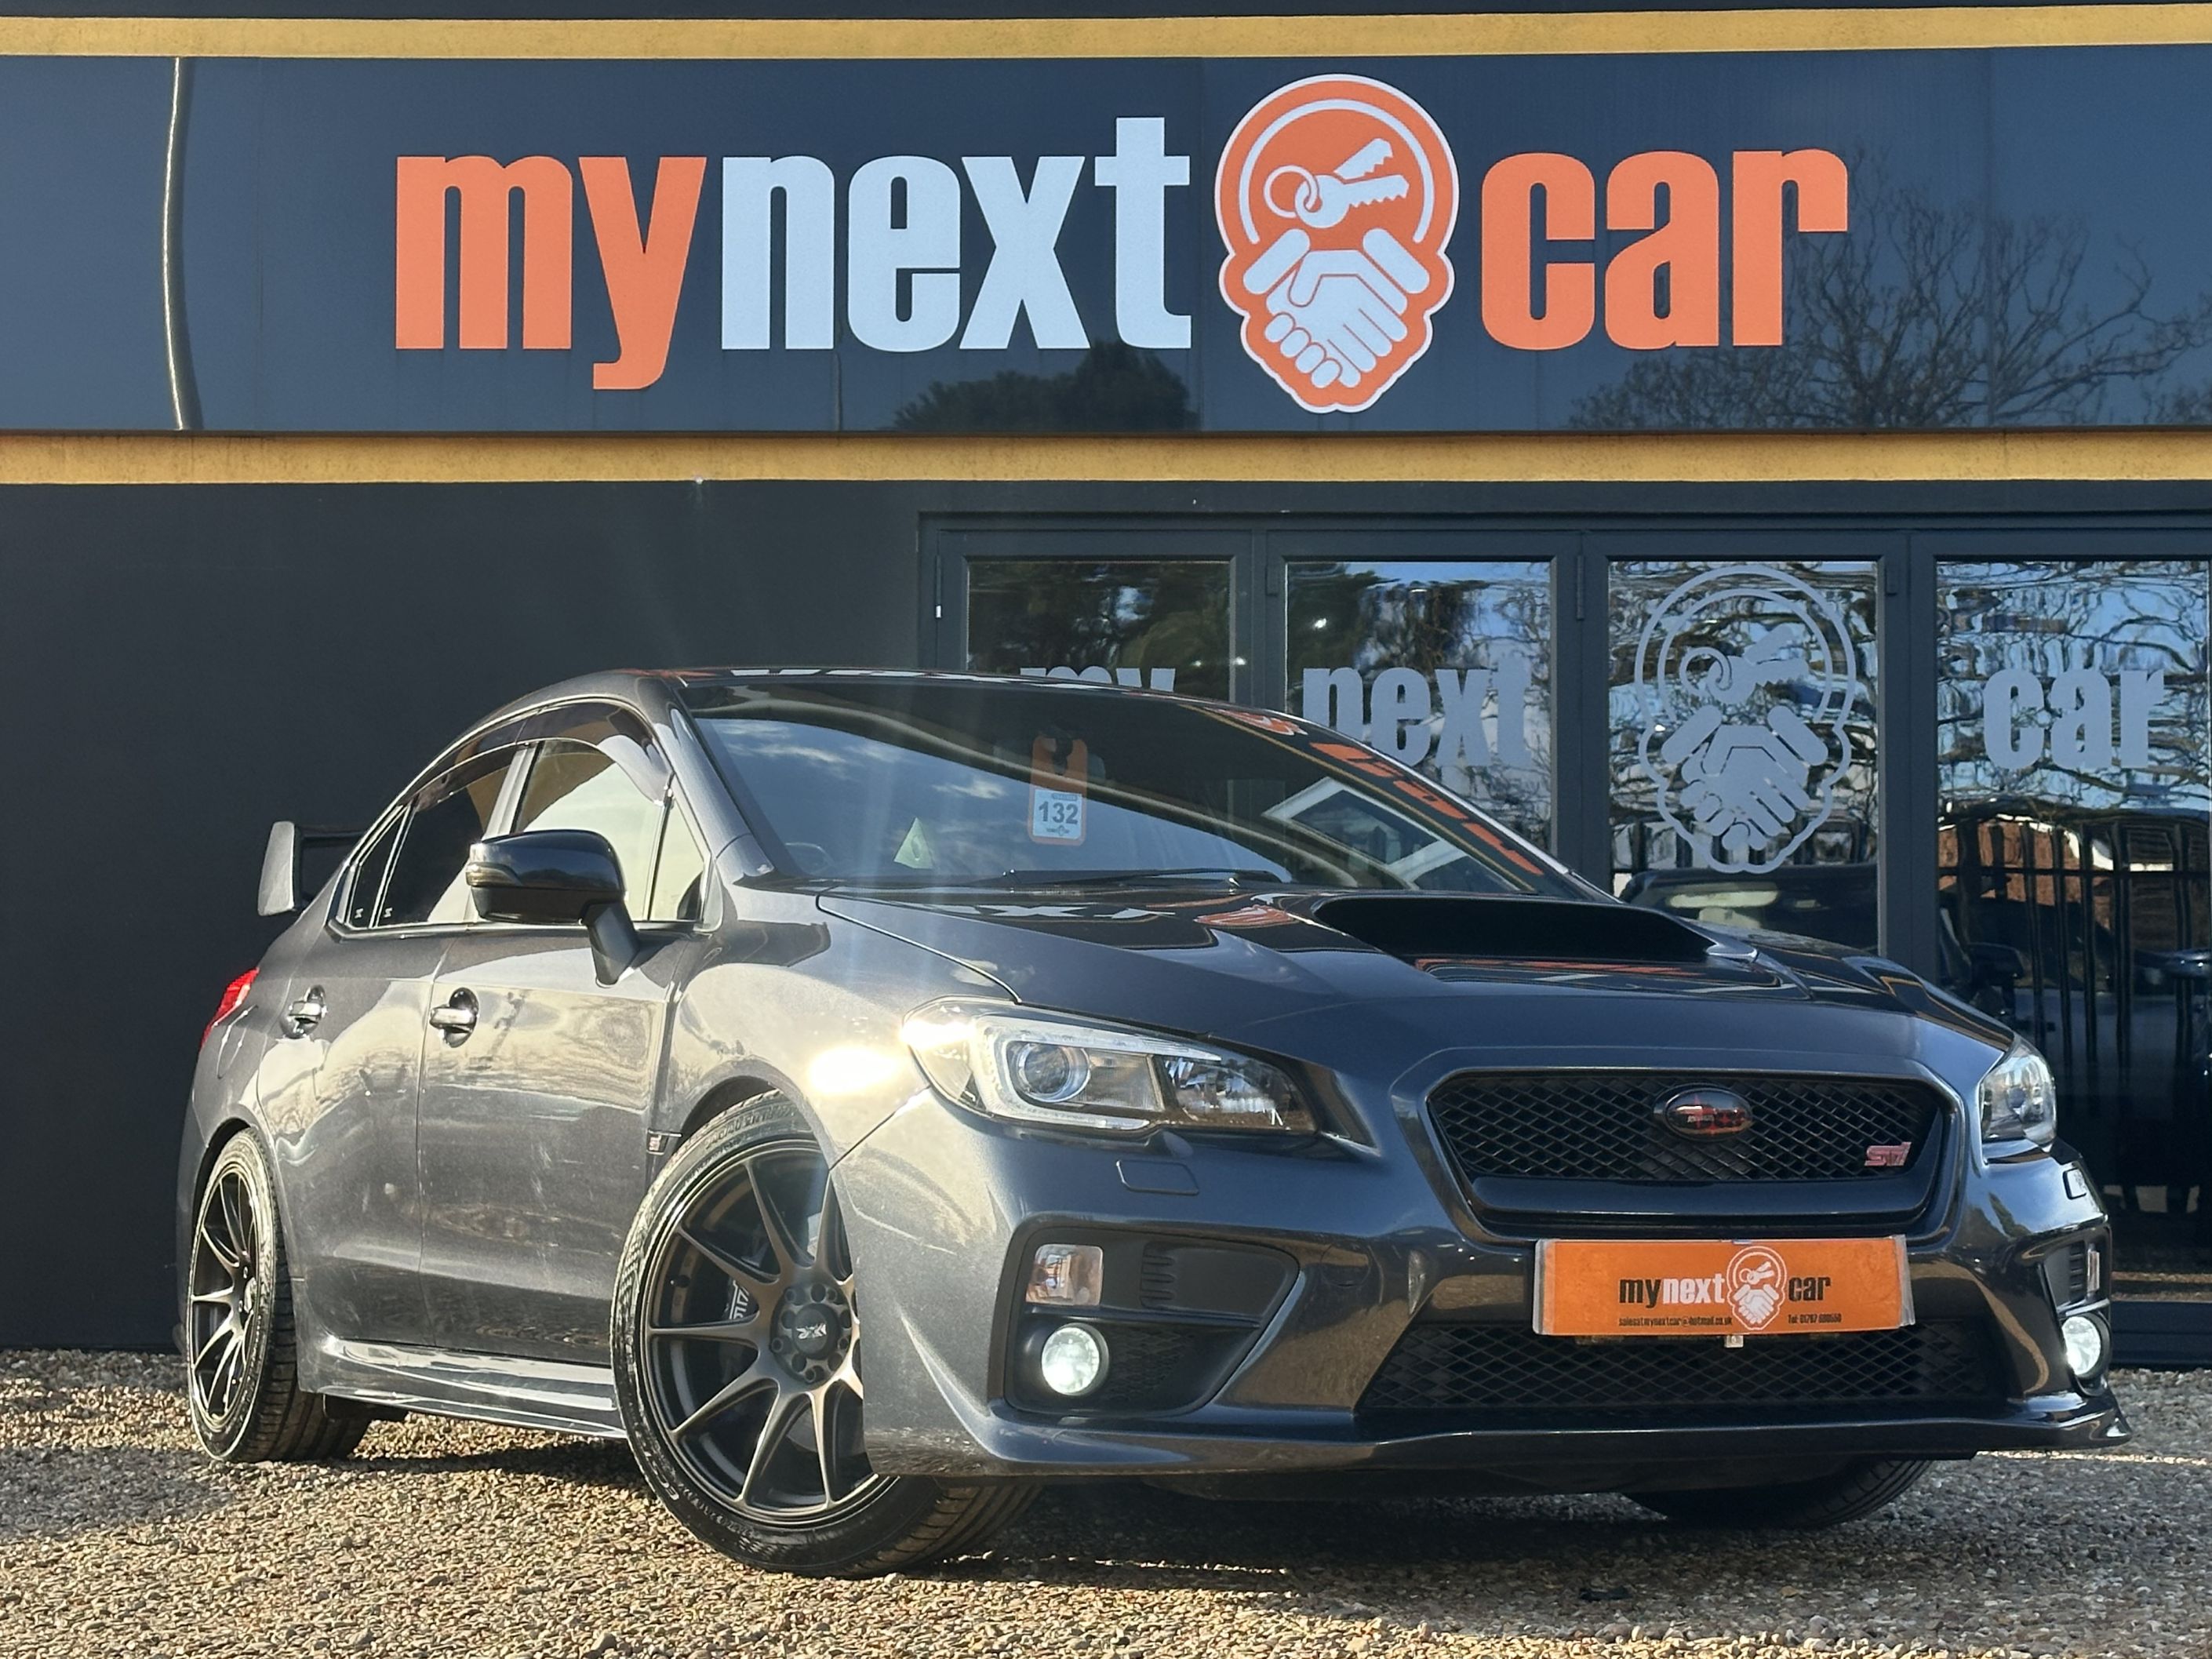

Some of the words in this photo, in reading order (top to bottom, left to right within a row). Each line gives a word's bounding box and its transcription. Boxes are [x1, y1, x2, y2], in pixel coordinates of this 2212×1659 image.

[1481, 148, 1849, 351] car
[1303, 655, 1532, 767] next
[1983, 668, 2165, 769] car
[1039, 801, 1079, 824] 132
[1788, 1276, 1831, 1301] car
